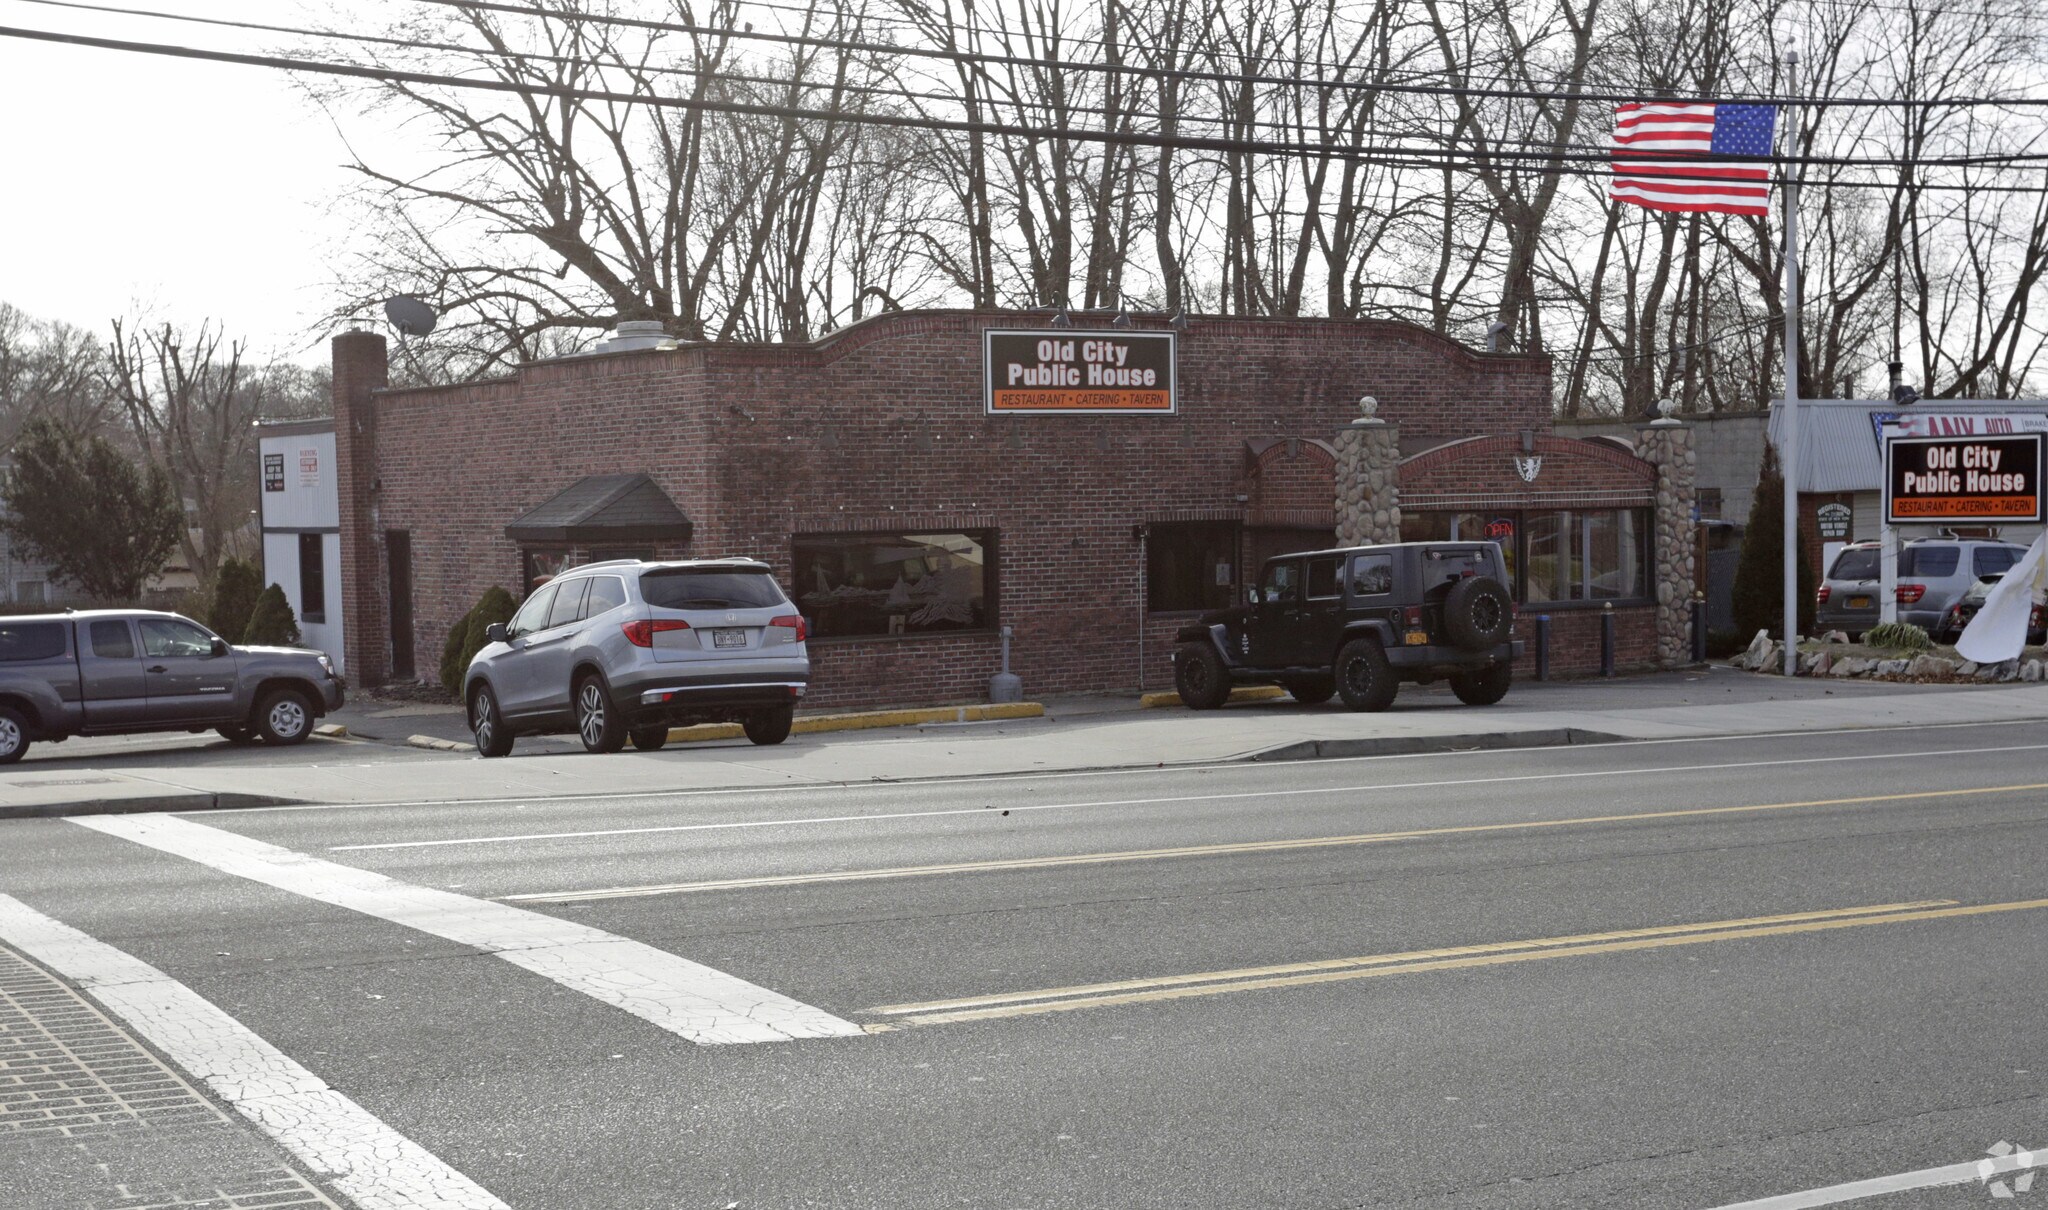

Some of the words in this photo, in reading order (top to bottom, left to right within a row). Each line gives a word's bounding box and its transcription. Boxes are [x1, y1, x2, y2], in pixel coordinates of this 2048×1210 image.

[1037, 340, 1075, 362] Old
[1082, 340, 1128, 367] City
[1007, 363, 1080, 386] Public
[1087, 363, 1156, 387] House
[1001, 393, 1067, 405] RESTAURANT
[1075, 393, 1120, 405] CATERING
[1129, 393, 1164, 405] TAVERN
[1926, 446, 1957, 469] Old
[1962, 445, 2002, 472] City
[1904, 471, 1961, 493] Public
[1966, 470, 2025, 492] House
[1817, 503, 1851, 516] REGISTERED
[1898, 501, 1948, 513] RESTAURANT
[1955, 500, 1993, 512] CATERING
[2000, 500, 2031, 512] TAVERN
[1484, 523, 1513, 537] OPEN
